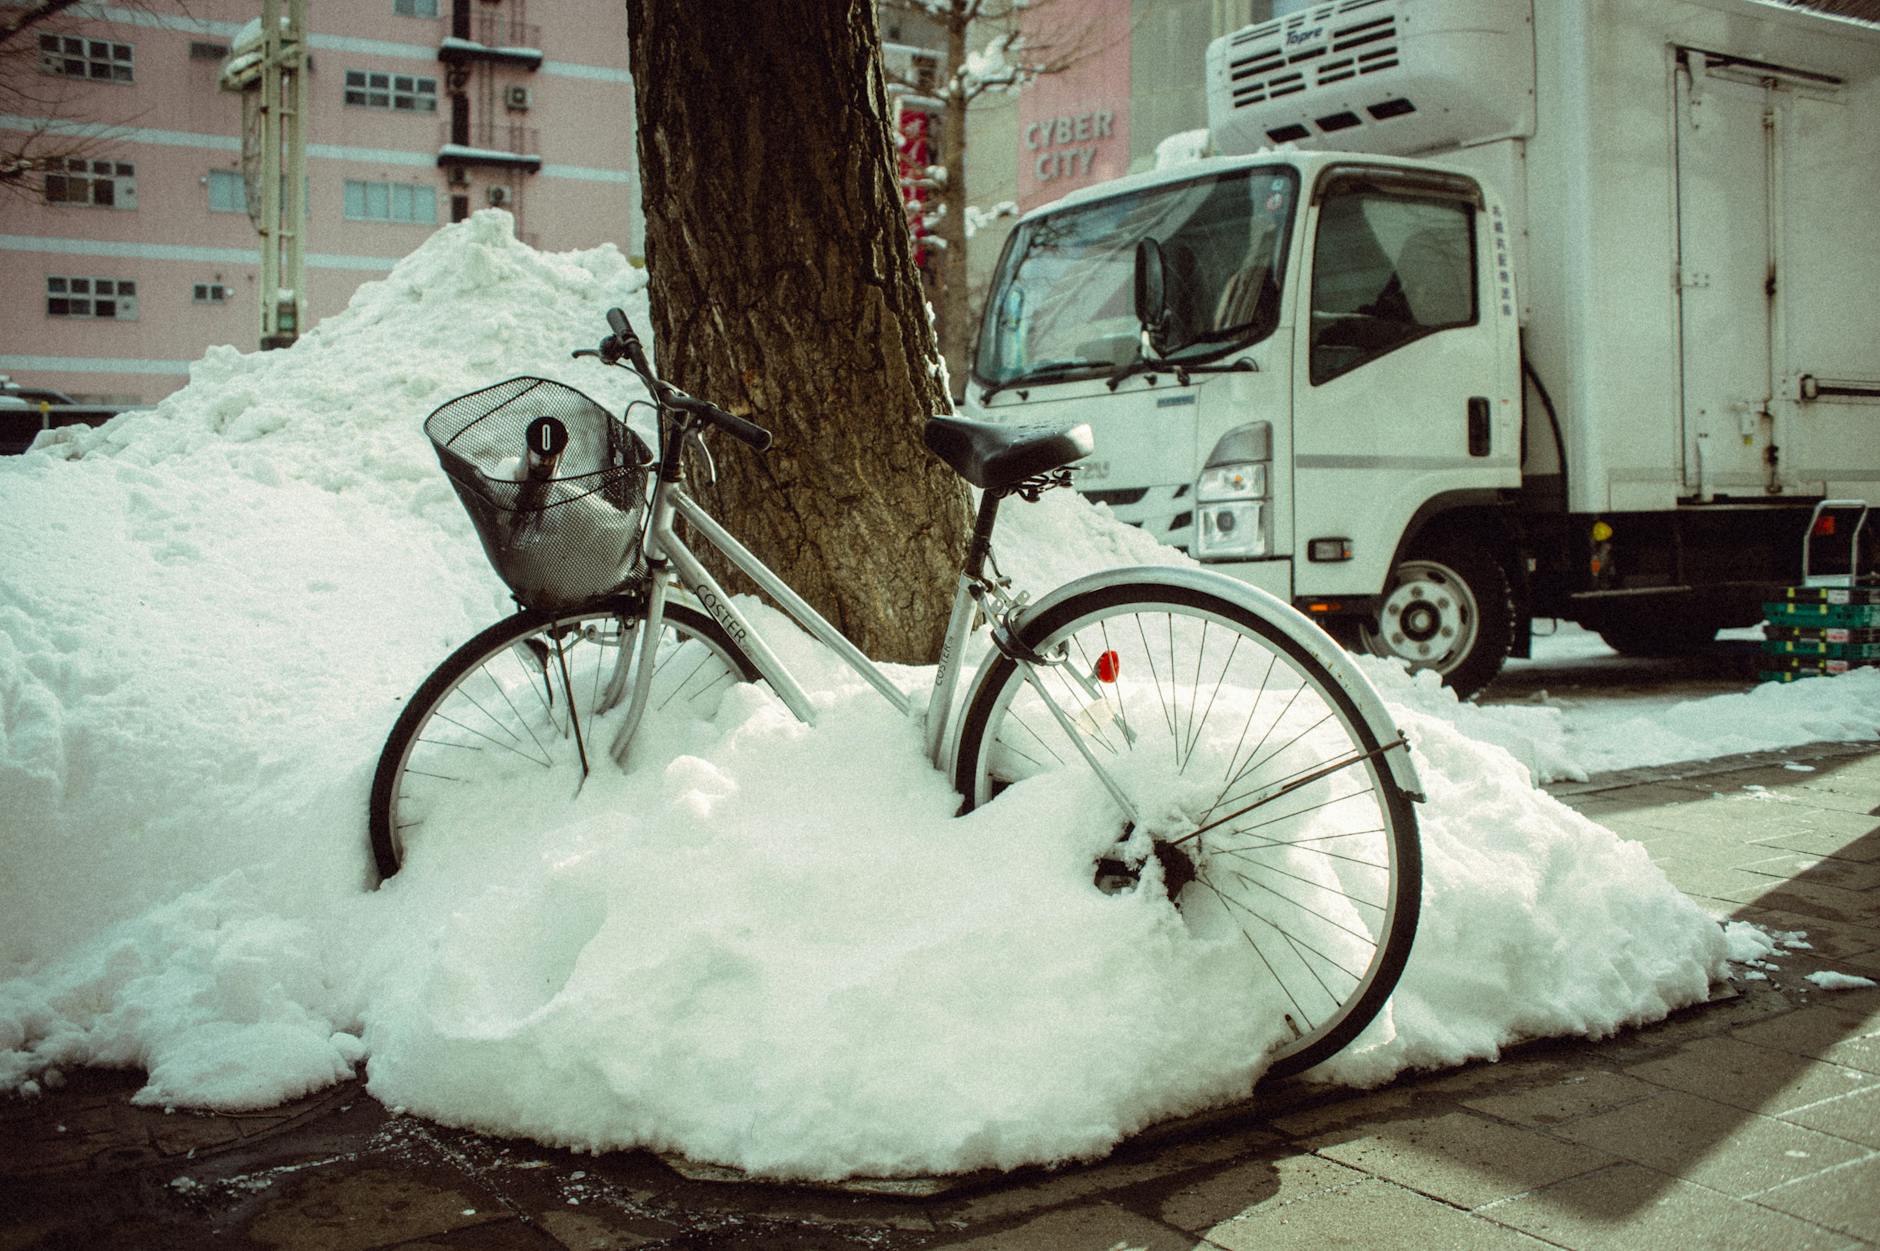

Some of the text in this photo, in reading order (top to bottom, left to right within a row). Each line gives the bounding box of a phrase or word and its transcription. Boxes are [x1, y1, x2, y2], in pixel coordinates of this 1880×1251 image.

[1286, 27, 1323, 45] Topre
[1025, 110, 1115, 151] CYBER
[1036, 145, 1097, 181] CITY
[696, 584, 746, 642] COSTER
[935, 644, 951, 686] COSTER
